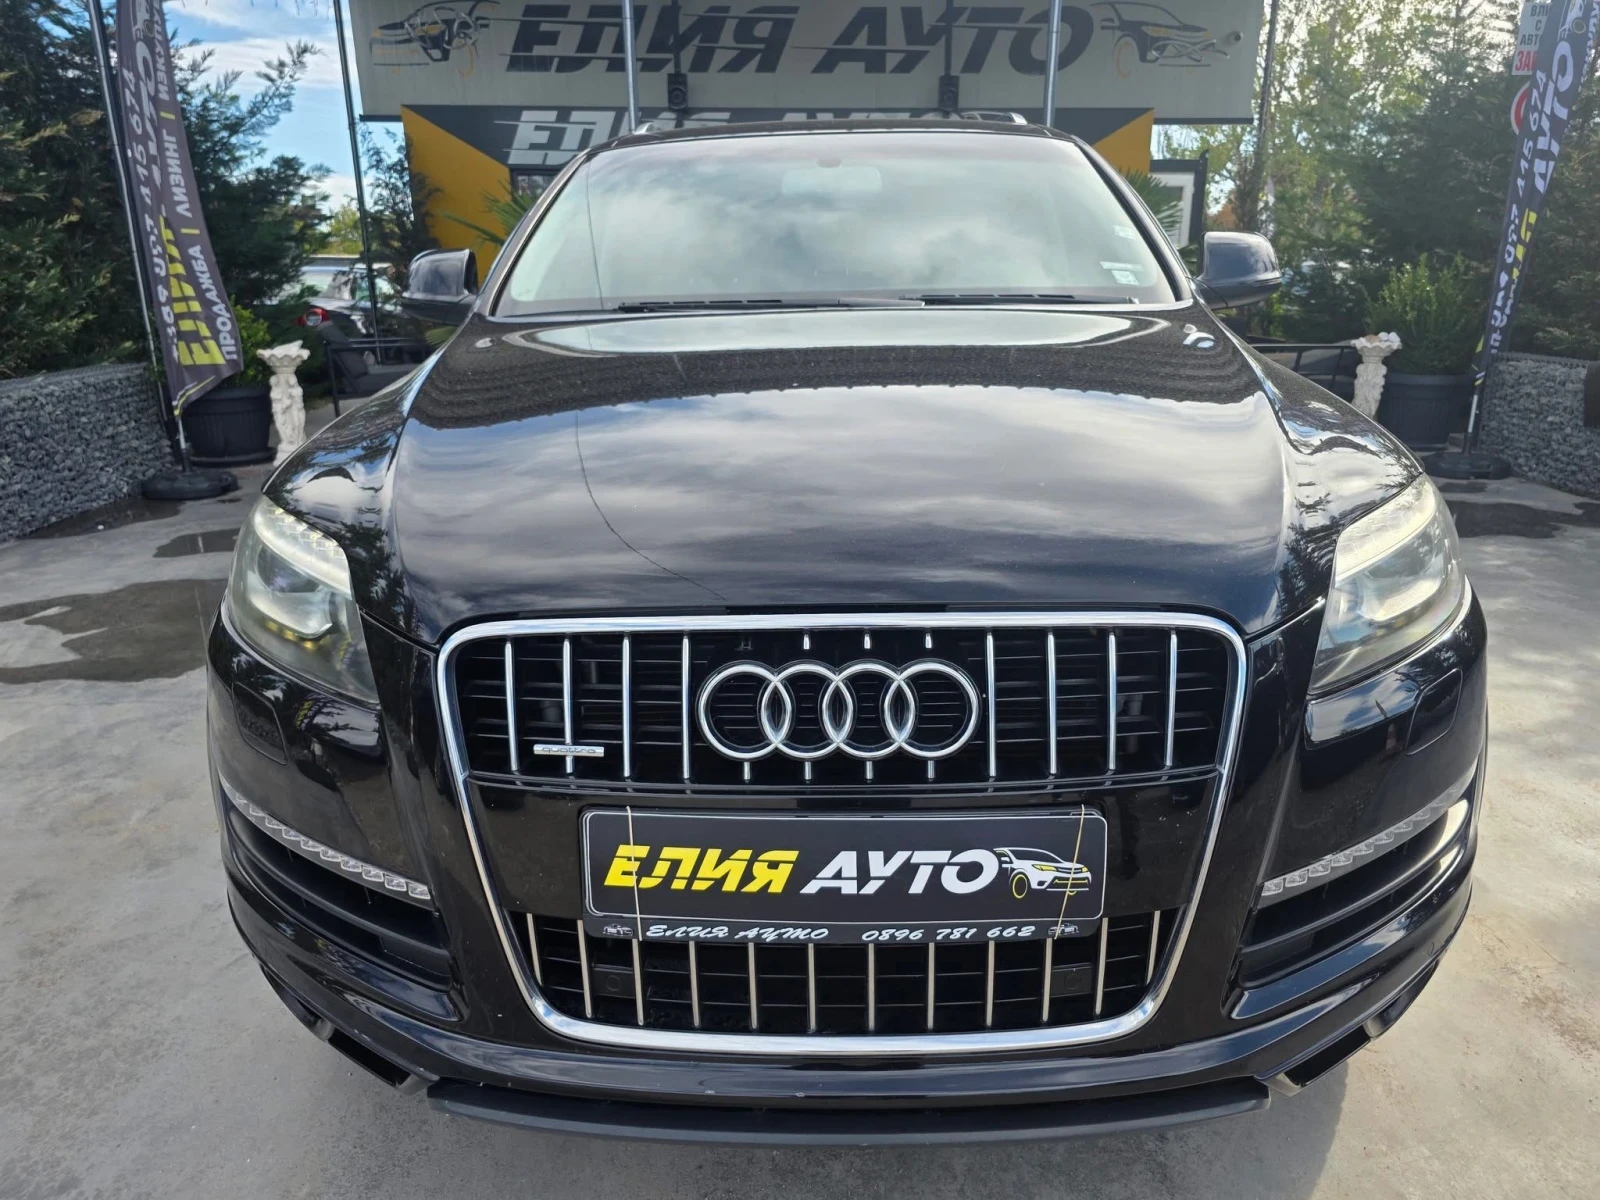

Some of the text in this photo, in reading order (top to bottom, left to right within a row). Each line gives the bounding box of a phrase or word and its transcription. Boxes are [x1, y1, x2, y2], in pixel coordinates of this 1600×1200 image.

[506, 4, 1094, 76] ЕЛИЯ АУТО
[1520, 34, 1540, 46] АВТ
[122, 67, 143, 135] 674
[1517, 137, 1534, 198] 415
[1529, 69, 1546, 132] 674
[134, 142, 152, 206] 415
[163, 129, 193, 219] ЛИЗИНГ
[188, 244, 238, 361] ПРОДАЖБА
[542, 746, 596, 754] quattro
[604, 844, 999, 895] ЕЛИЯ АУТО
[861, 928, 925, 941] 0896
[936, 927, 978, 940] 781
[986, 925, 1036, 938] 662
